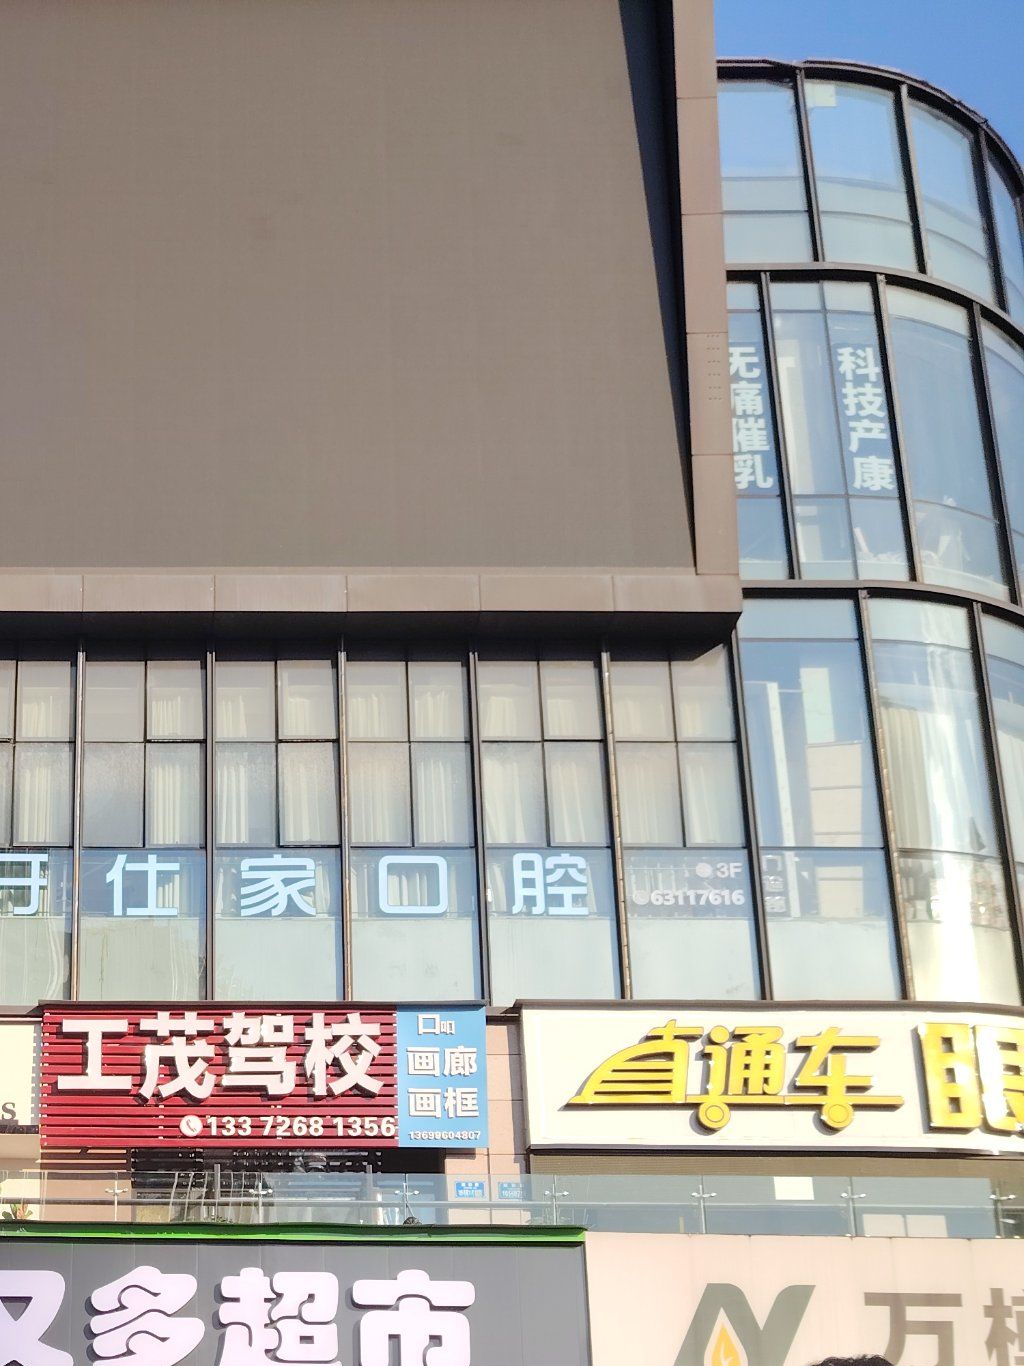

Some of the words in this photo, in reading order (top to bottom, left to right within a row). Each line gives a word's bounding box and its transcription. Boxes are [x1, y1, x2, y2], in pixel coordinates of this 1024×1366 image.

[728, 346, 773, 490] 无痛催乳
[837, 347, 896, 491] 科技产康
[716, 862, 743, 879] 3F
[651, 889, 746, 906] 63117616
[57, 1012, 384, 1101] 工茂驾校
[406, 1046, 478, 1076] 画廊
[566, 1020, 903, 1130] 直通车
[408, 1087, 480, 1118] 画框
[206, 1116, 252, 1137] 133
[260, 1116, 324, 1137] 7268
[333, 1116, 396, 1137] 1356
